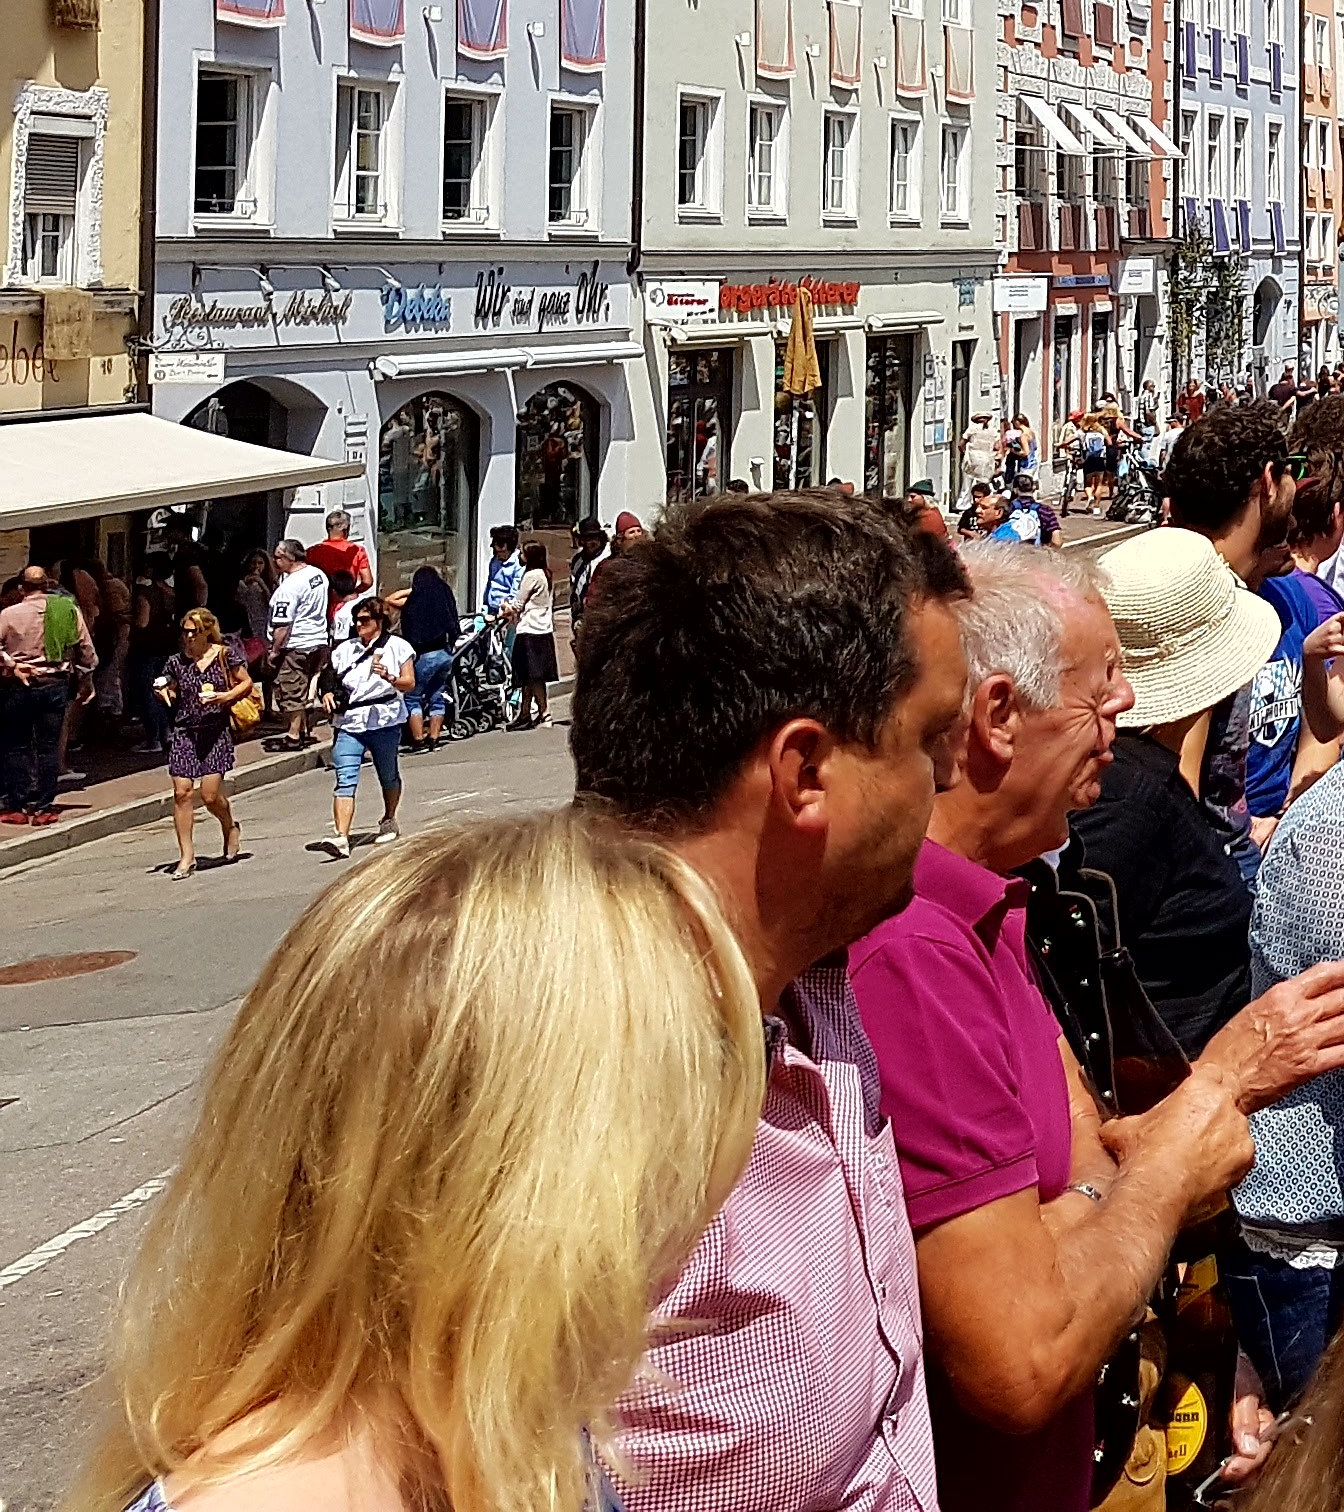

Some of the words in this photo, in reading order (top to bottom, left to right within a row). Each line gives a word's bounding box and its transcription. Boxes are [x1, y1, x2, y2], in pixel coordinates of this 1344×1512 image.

[168, 293, 271, 325] Restaurant
[379, 283, 453, 322] Debeka
[475, 266, 510, 321] Wir
[512, 289, 535, 316] sind
[538, 292, 570, 332] ganz
[100, 358, 113, 375] 10
